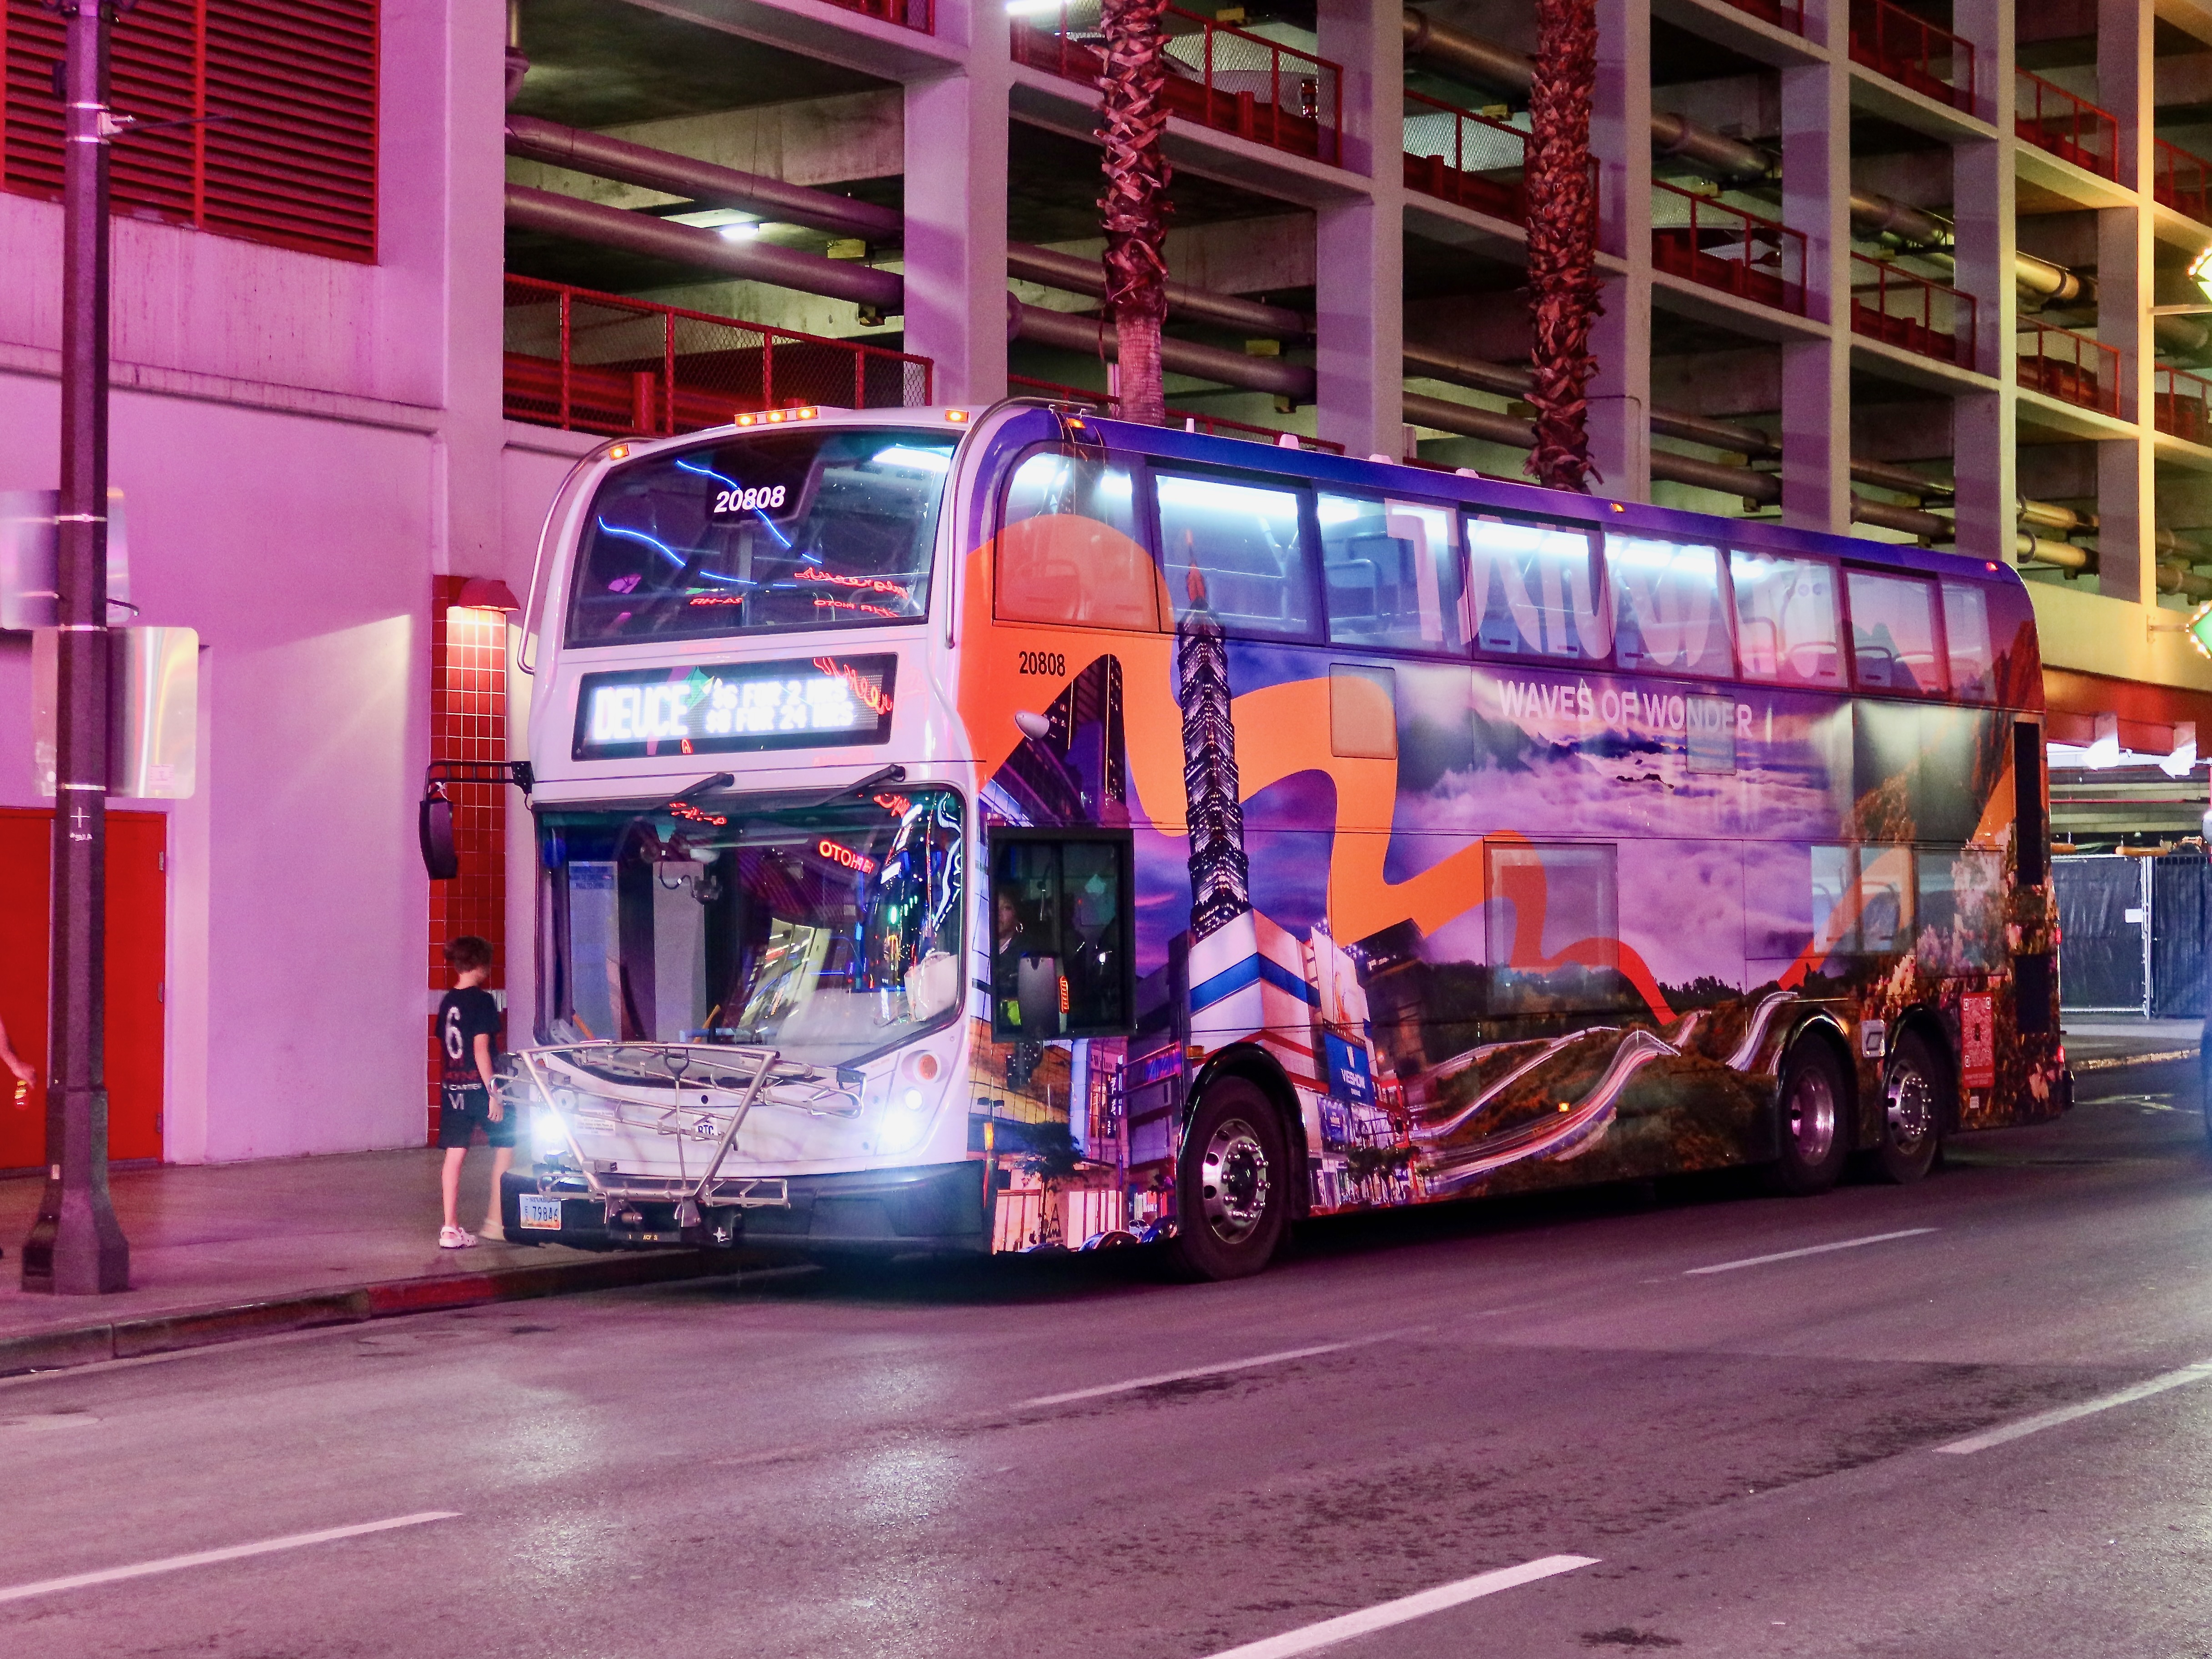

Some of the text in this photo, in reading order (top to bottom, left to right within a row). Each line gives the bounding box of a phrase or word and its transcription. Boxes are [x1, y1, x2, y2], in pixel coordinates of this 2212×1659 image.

[714, 485, 786, 513] 20808
[1019, 651, 1066, 677] 20808
[742, 681, 782, 707] FOR
[787, 680, 802, 705] 2
[594, 684, 690, 739] DEUCE
[736, 707, 774, 731] FOR
[779, 704, 807, 729] 24
[1497, 679, 1753, 738] WAVES OF WONDER
[445, 1006, 463, 1060] 6
[533, 1206, 558, 1222] 79846
